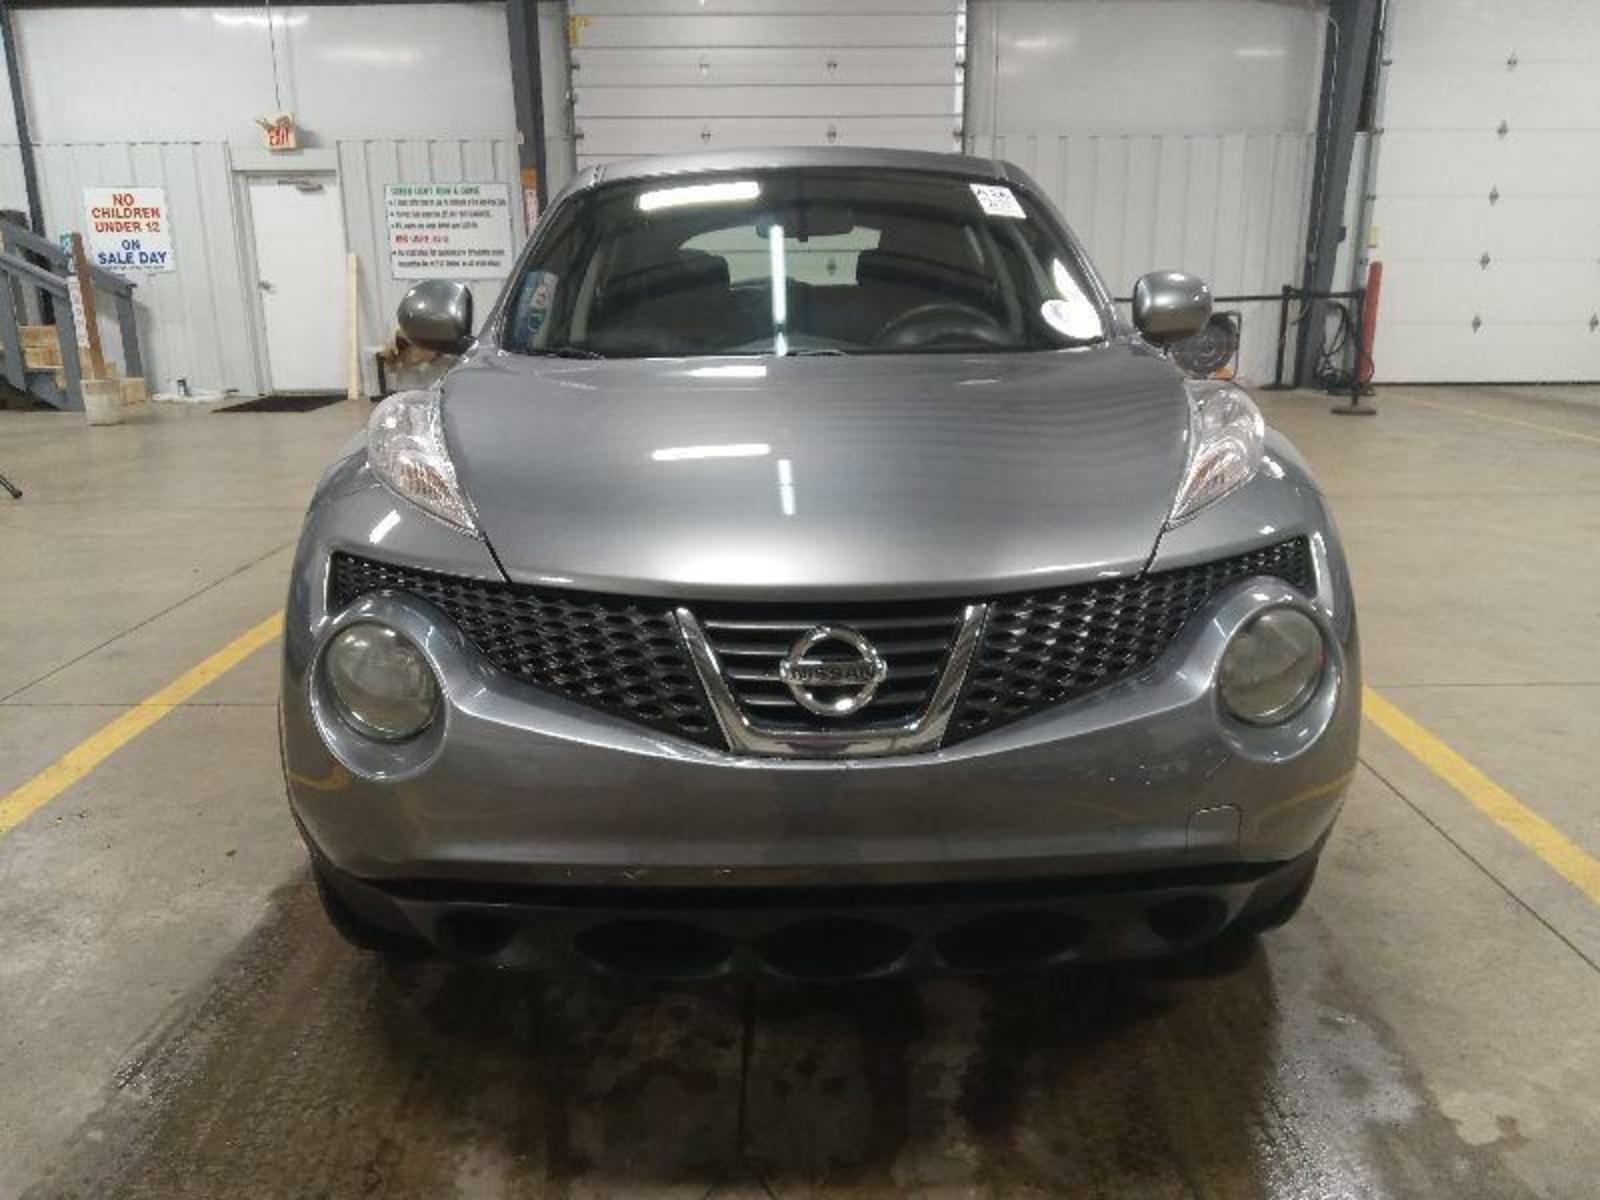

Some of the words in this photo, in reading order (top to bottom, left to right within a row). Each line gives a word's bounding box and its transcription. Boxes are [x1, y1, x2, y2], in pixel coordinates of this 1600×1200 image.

[112, 193, 135, 206] NO
[91, 207, 161, 219] CHILDREN
[95, 221, 142, 233] UNDER
[145, 221, 161, 233] 12
[121, 239, 141, 251] ON
[98, 252, 134, 265] SALE
[139, 251, 167, 264] DAY
[791, 665, 872, 681] NISSAN
